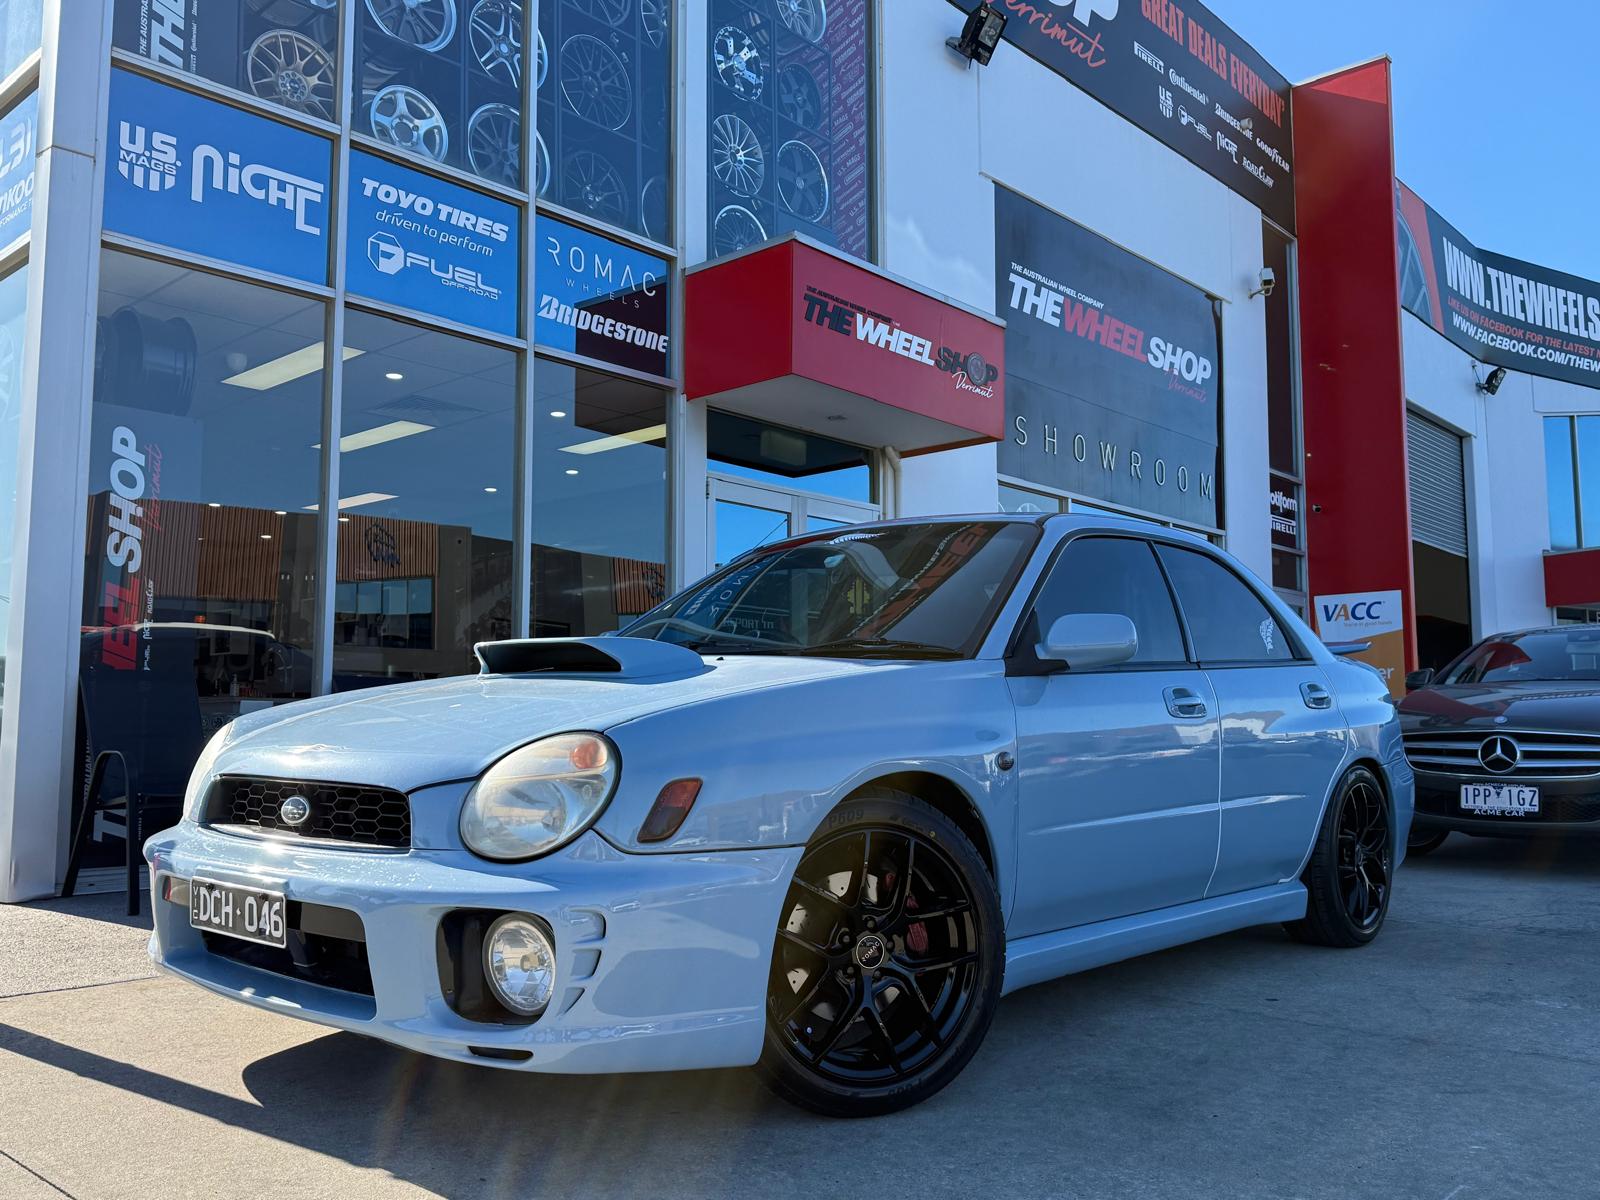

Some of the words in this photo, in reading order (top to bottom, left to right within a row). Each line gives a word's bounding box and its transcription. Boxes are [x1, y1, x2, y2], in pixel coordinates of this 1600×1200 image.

[1141, 0, 1185, 46] GREAT
[1188, 17, 1227, 80] DEALS
[1133, 40, 1165, 75] PIRELLI
[1169, 68, 1206, 106] Continental
[1256, 137, 1290, 173] GOODYEAR
[119, 151, 177, 176] MAGS
[361, 177, 434, 216] TOYO
[437, 202, 509, 242] TIRES
[423, 224, 438, 239] to
[438, 232, 493, 257] perform
[406, 251, 498, 294] FUEL
[547, 236, 656, 297] ROMAC
[1011, 261, 1024, 273] THE
[1022, 267, 1059, 290] AUSTRALIAN
[1058, 283, 1077, 298] WHEEL
[1077, 292, 1105, 310] COMPANY
[565, 277, 640, 309] WHEELS
[536, 293, 670, 353] BRIDGESTONE
[803, 292, 856, 337] THE
[856, 312, 936, 367] WHEEL
[935, 345, 999, 387] SHOP
[1008, 272, 1065, 328] THE
[1063, 295, 1148, 364] WHEEL
[1147, 336, 1212, 385] SHOP
[1480, 315, 1524, 340] FACEBOOK
[1525, 331, 1544, 345] FOR
[1544, 336, 1563, 350] THE
[1562, 341, 1595, 357] LATEST
[951, 371, 994, 399] Derrimut
[1014, 415, 1212, 500] SHOWROOM
[106, 425, 146, 574] SHOP
[1323, 601, 1382, 622] VACC
[1464, 786, 1491, 805] 1PP
[1507, 789, 1537, 807] 1GZ
[1473, 808, 1502, 817] ACME
[1504, 810, 1526, 818] CAR
[199, 886, 233, 928] DCH
[244, 895, 284, 938] 046
